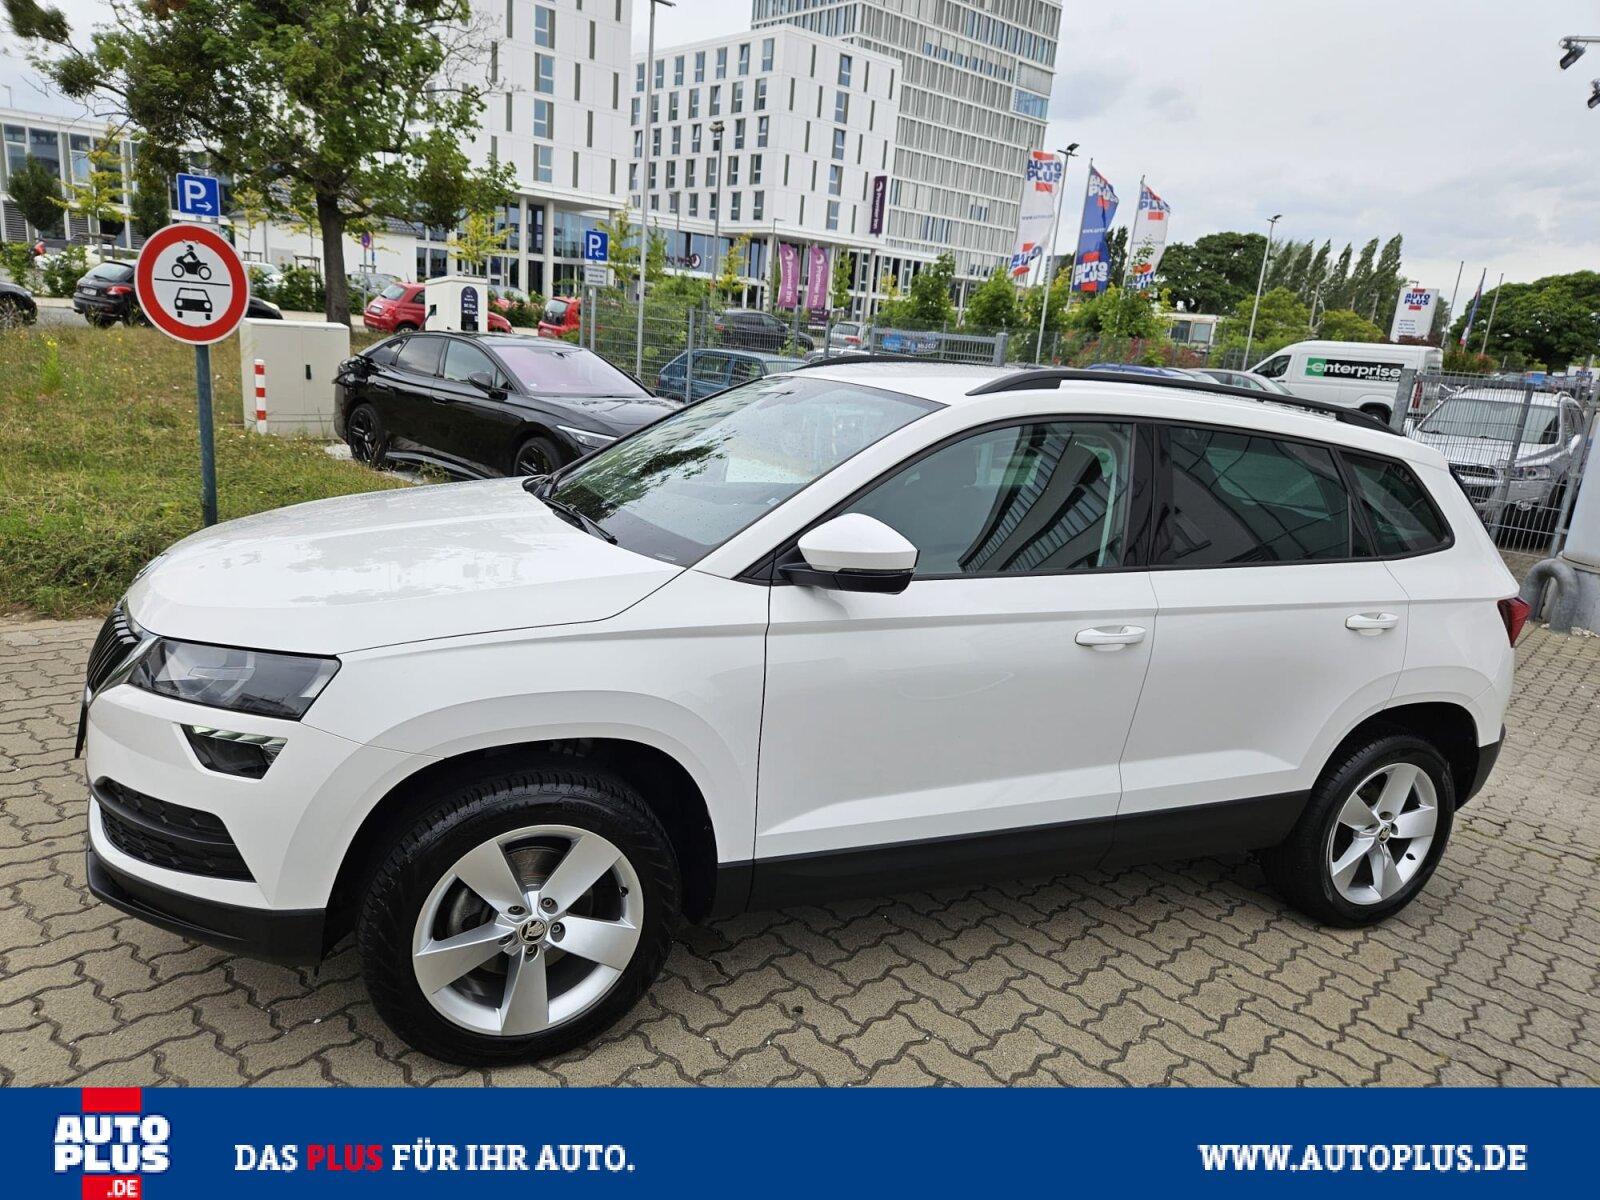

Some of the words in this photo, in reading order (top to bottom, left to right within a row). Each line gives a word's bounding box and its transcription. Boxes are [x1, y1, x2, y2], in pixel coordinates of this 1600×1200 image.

[1027, 160, 1062, 172] AUTO
[1027, 170, 1062, 182] PLUS
[184, 180, 206, 210] P
[588, 234, 602, 257] P
[785, 261, 793, 291] Premier
[1075, 262, 1108, 276] AUTO
[814, 265, 824, 295] Premier
[1074, 272, 1107, 286] PLUS
[785, 290, 793, 303] Inn
[812, 294, 820, 306] Inn
[1311, 362, 1402, 377] enterprise
